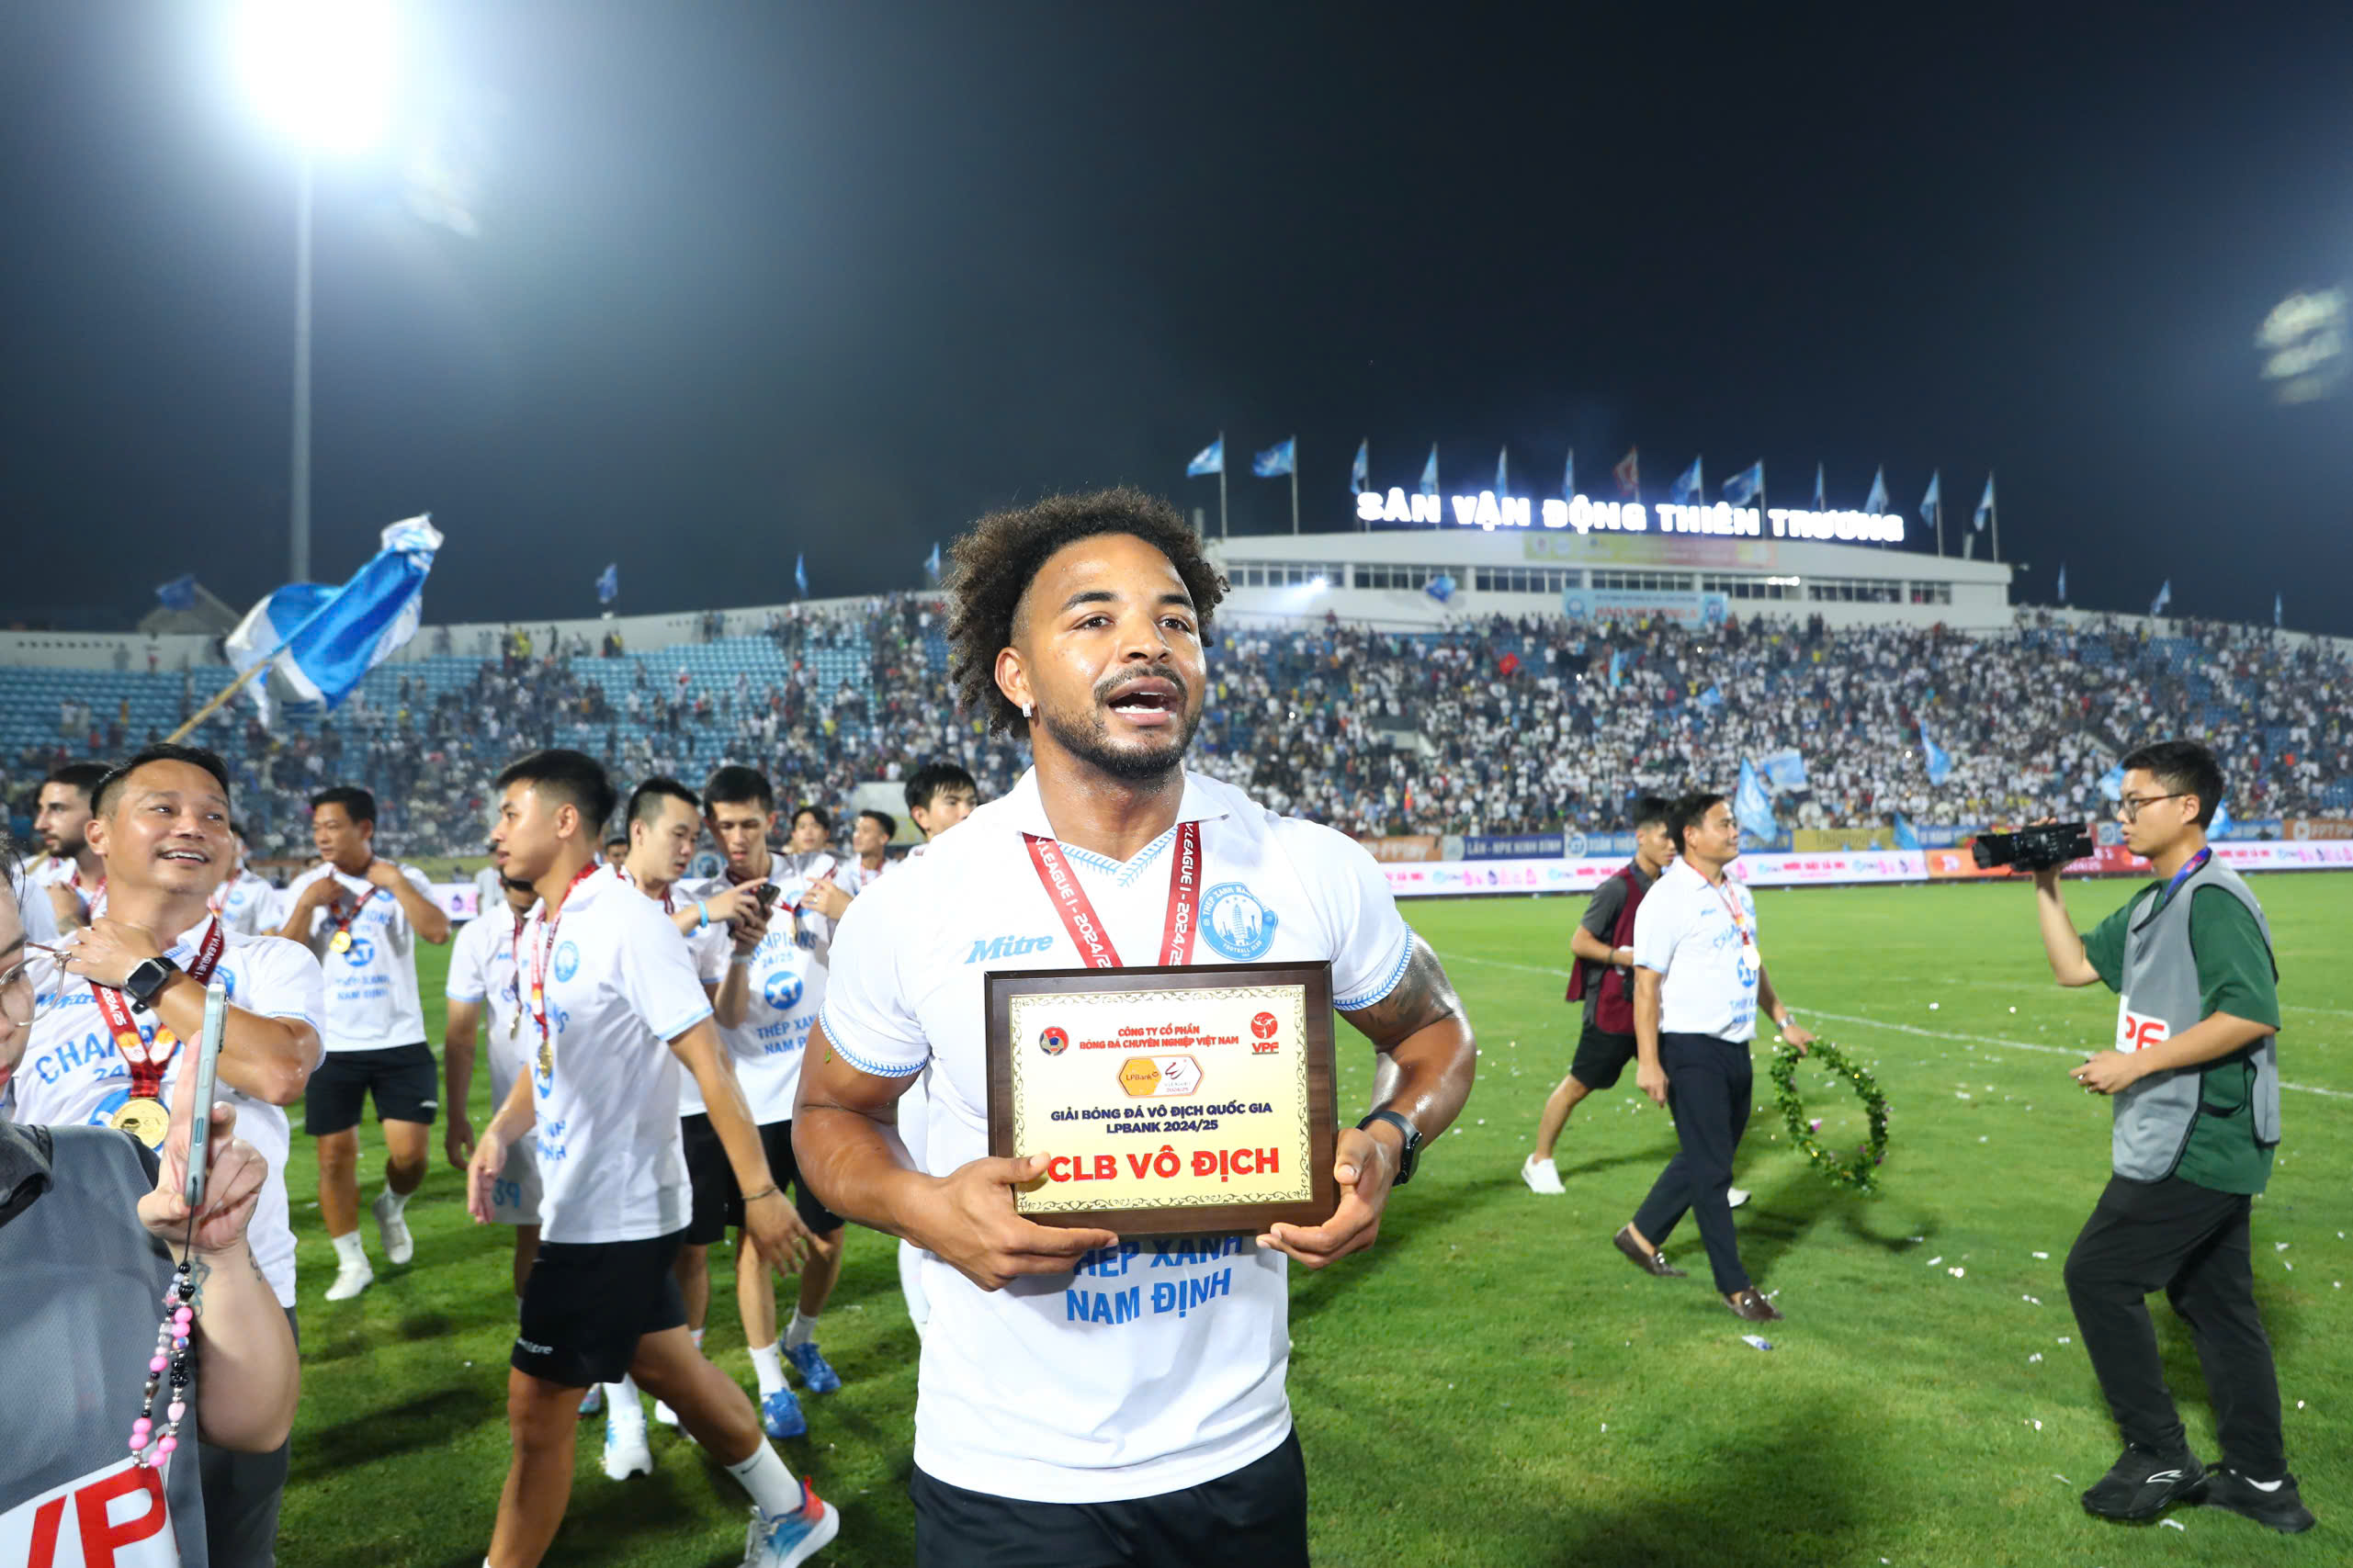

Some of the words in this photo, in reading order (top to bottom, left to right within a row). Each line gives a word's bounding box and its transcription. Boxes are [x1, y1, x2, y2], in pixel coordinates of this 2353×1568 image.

[1357, 487, 1441, 523] SÂN
[1452, 491, 1531, 531] VẬN
[1543, 494, 1646, 534] ĐỘNG
[1656, 502, 1760, 536] THIÊN
[1180, 822, 1194, 885] V.LEAGUE
[963, 934, 1054, 964] Mitre
[1074, 912, 1113, 967] 2024/2
[1118, 1025, 1145, 1037] CÔNG
[1146, 1027, 1158, 1036] TY
[1123, 1037, 1160, 1048] CHUYÊN
[1161, 1035, 1194, 1048] NGHIỆP
[1196, 1034, 1217, 1046] VIỆT
[1218, 1035, 1239, 1045] NAM
[764, 1039, 795, 1055] NAM
[1251, 1042, 1280, 1054] VPF
[1125, 1073, 1152, 1081] LPBank
[1050, 1106, 1079, 1121] GIẢI
[1081, 1107, 1121, 1120] BÓNG
[1124, 1105, 1145, 1118] ĐÁ
[1147, 1104, 1168, 1118] VÔ
[1170, 1104, 1204, 1119] ĐỊCH
[1206, 1100, 1246, 1115] QUỐC
[1248, 1102, 1273, 1114] GIA
[1106, 1122, 1161, 1134] LPBANK
[1163, 1119, 1219, 1133] 2024/25
[1047, 1155, 1118, 1183] CLB
[1126, 1145, 1181, 1179] VÔ
[1191, 1147, 1280, 1182] ĐỊCH
[1150, 1235, 1243, 1269] XANH
[1066, 1285, 1140, 1325] NAM
[1150, 1268, 1232, 1318] ĐỊNH
